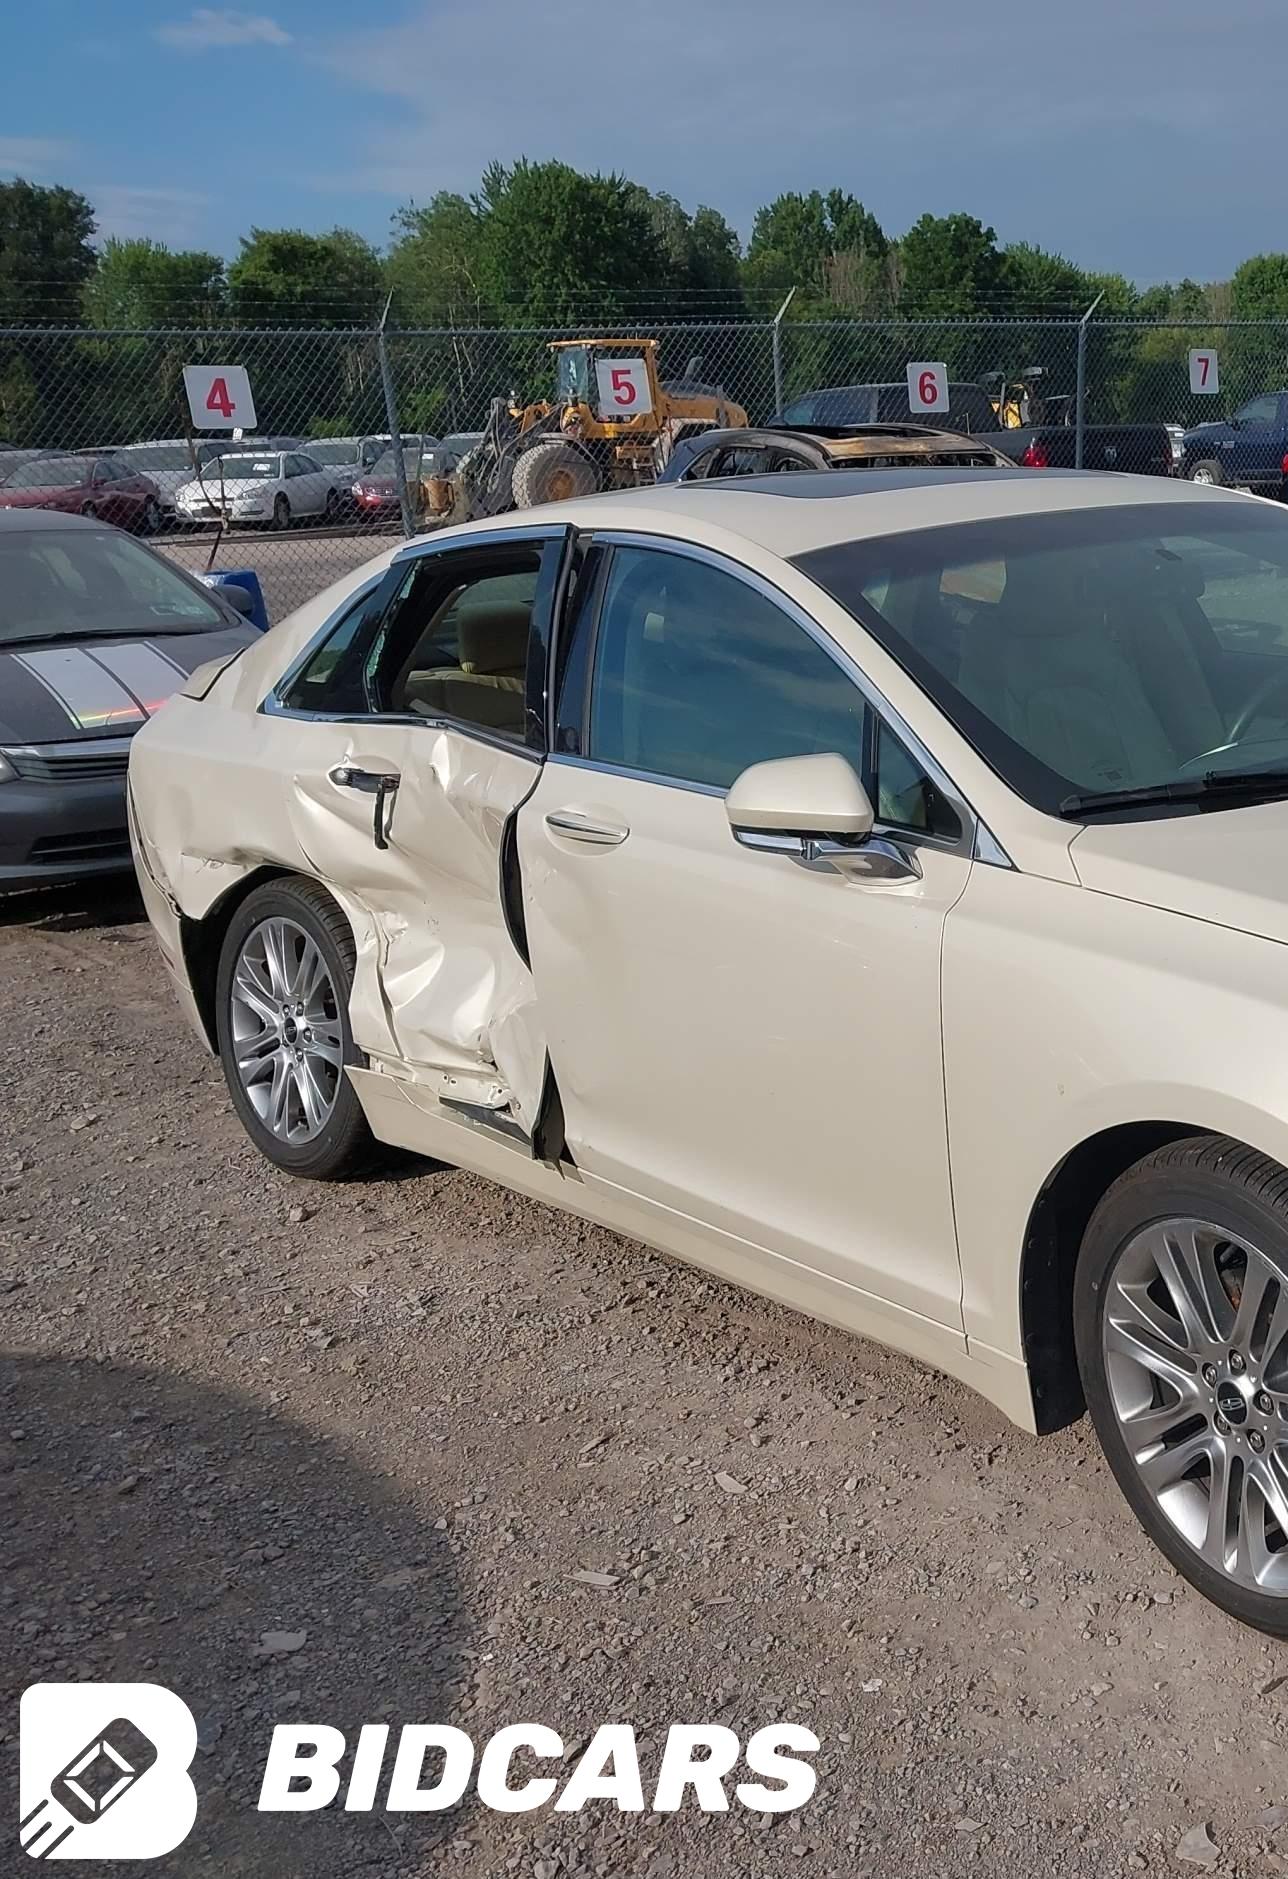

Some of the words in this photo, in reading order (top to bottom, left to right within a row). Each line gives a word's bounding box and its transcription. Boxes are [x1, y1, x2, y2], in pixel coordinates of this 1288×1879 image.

[611, 369, 636, 405] 5
[918, 371, 938, 405] 6
[1197, 357, 1209, 386] 7
[206, 377, 236, 418] 4
